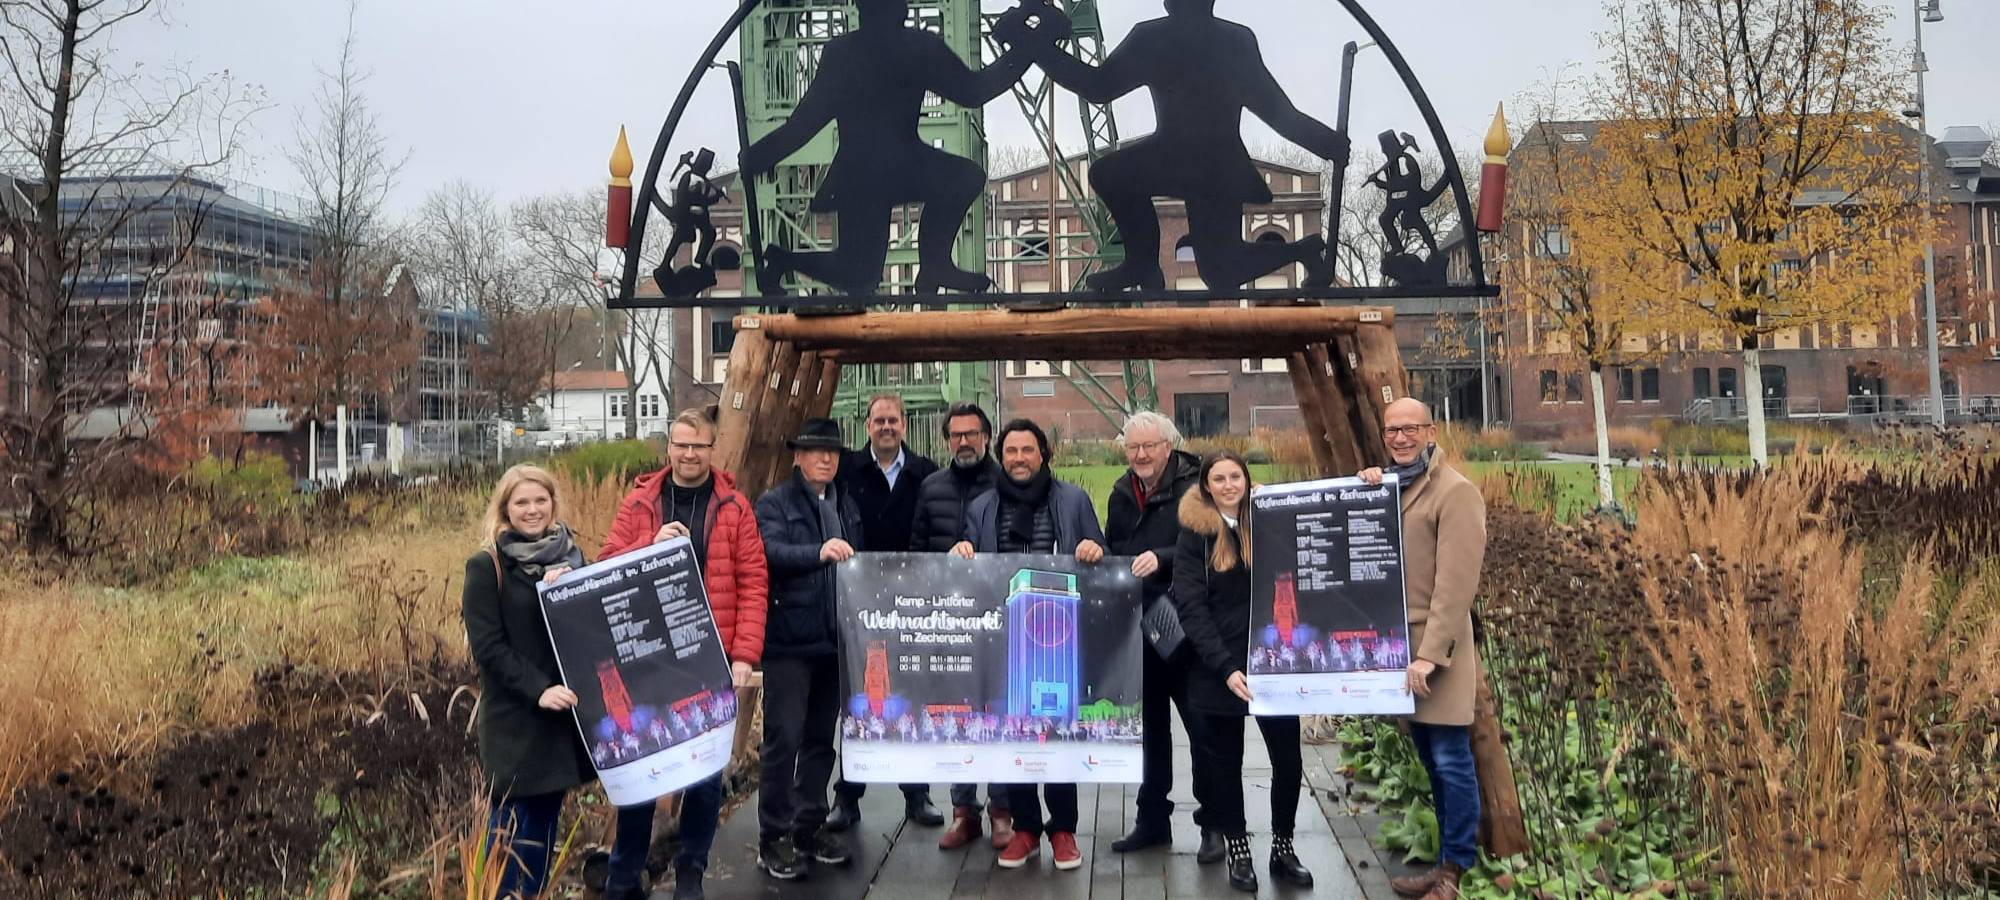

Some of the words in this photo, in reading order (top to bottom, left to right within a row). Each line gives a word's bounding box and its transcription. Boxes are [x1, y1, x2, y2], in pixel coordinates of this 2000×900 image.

[895, 595, 924, 608] Kamp
[932, 594, 976, 607] Lintförter
[858, 609, 1003, 630] Weihnachtsmarkt
[914, 632, 973, 644] Zechenpark
